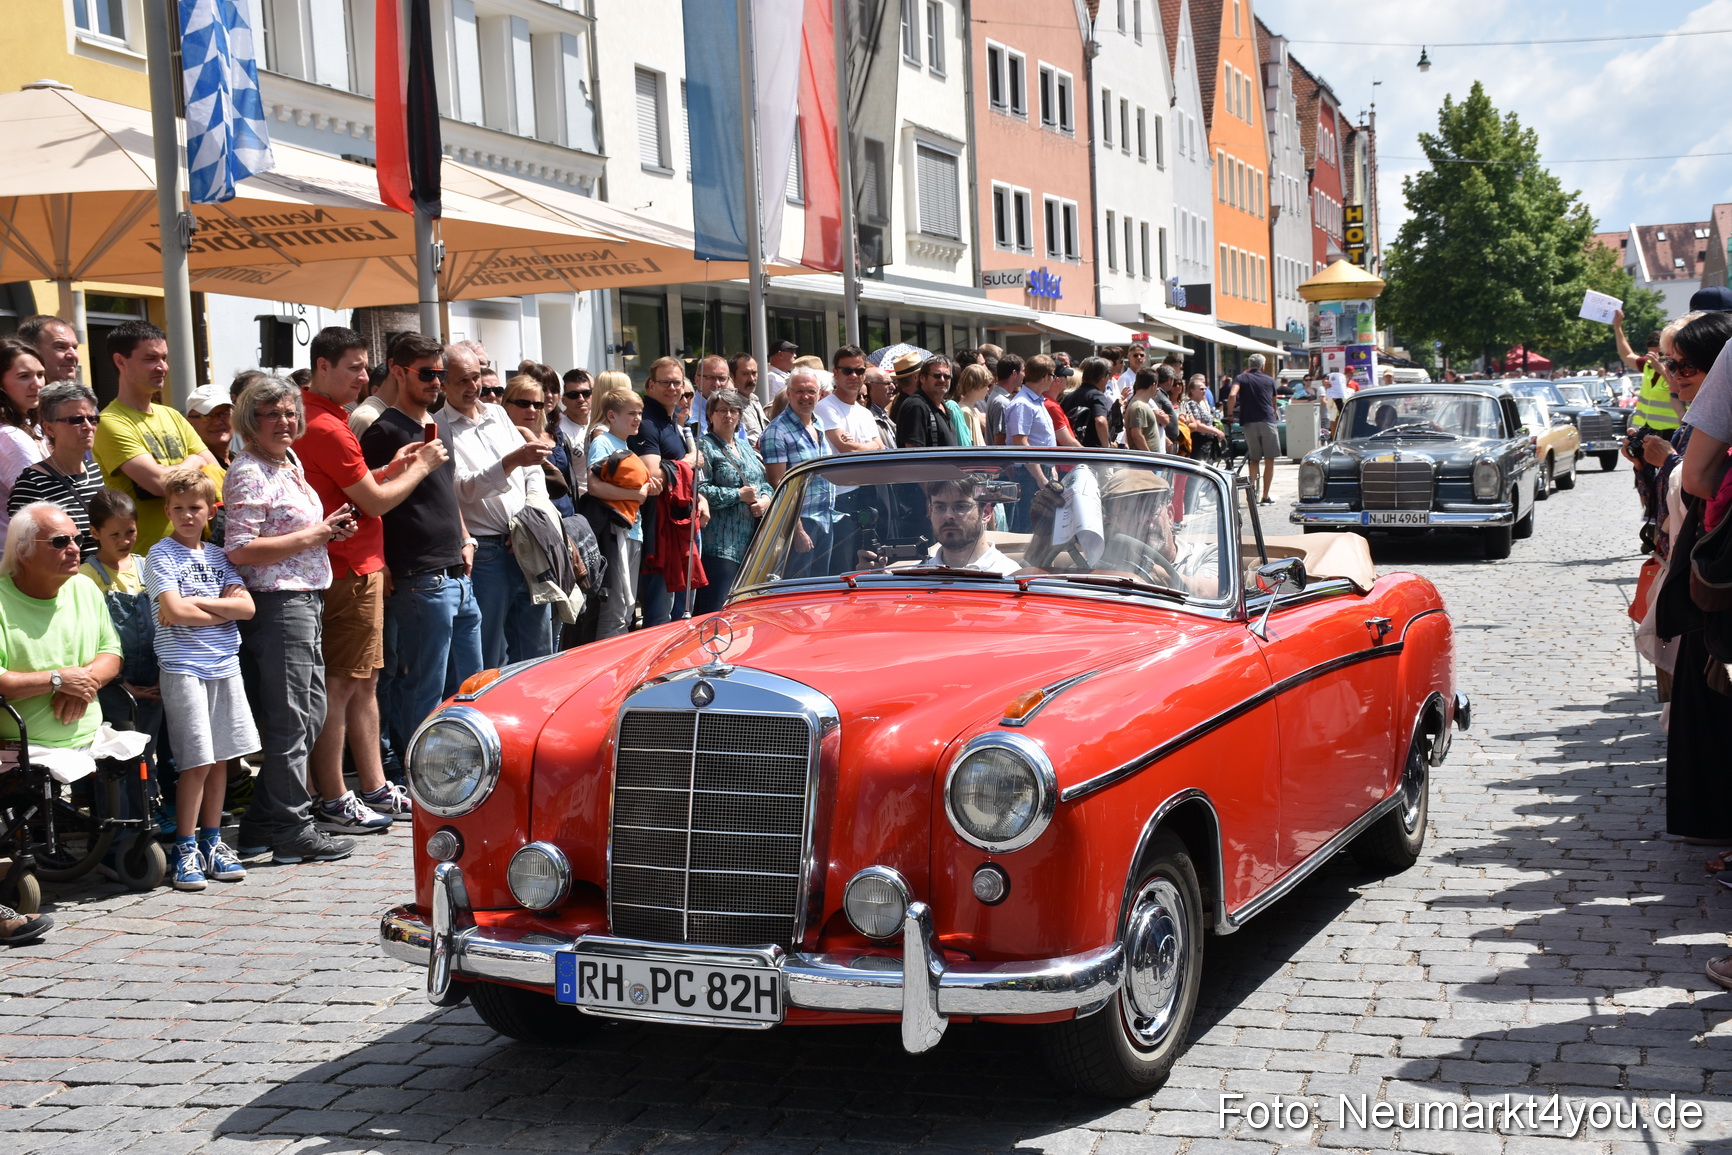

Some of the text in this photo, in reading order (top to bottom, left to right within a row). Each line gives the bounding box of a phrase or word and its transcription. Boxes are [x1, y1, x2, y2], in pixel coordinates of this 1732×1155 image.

[1369, 513, 1426, 523] N UH 496H
[563, 983, 571, 994] D
[578, 960, 778, 1015] RH PC 82H
